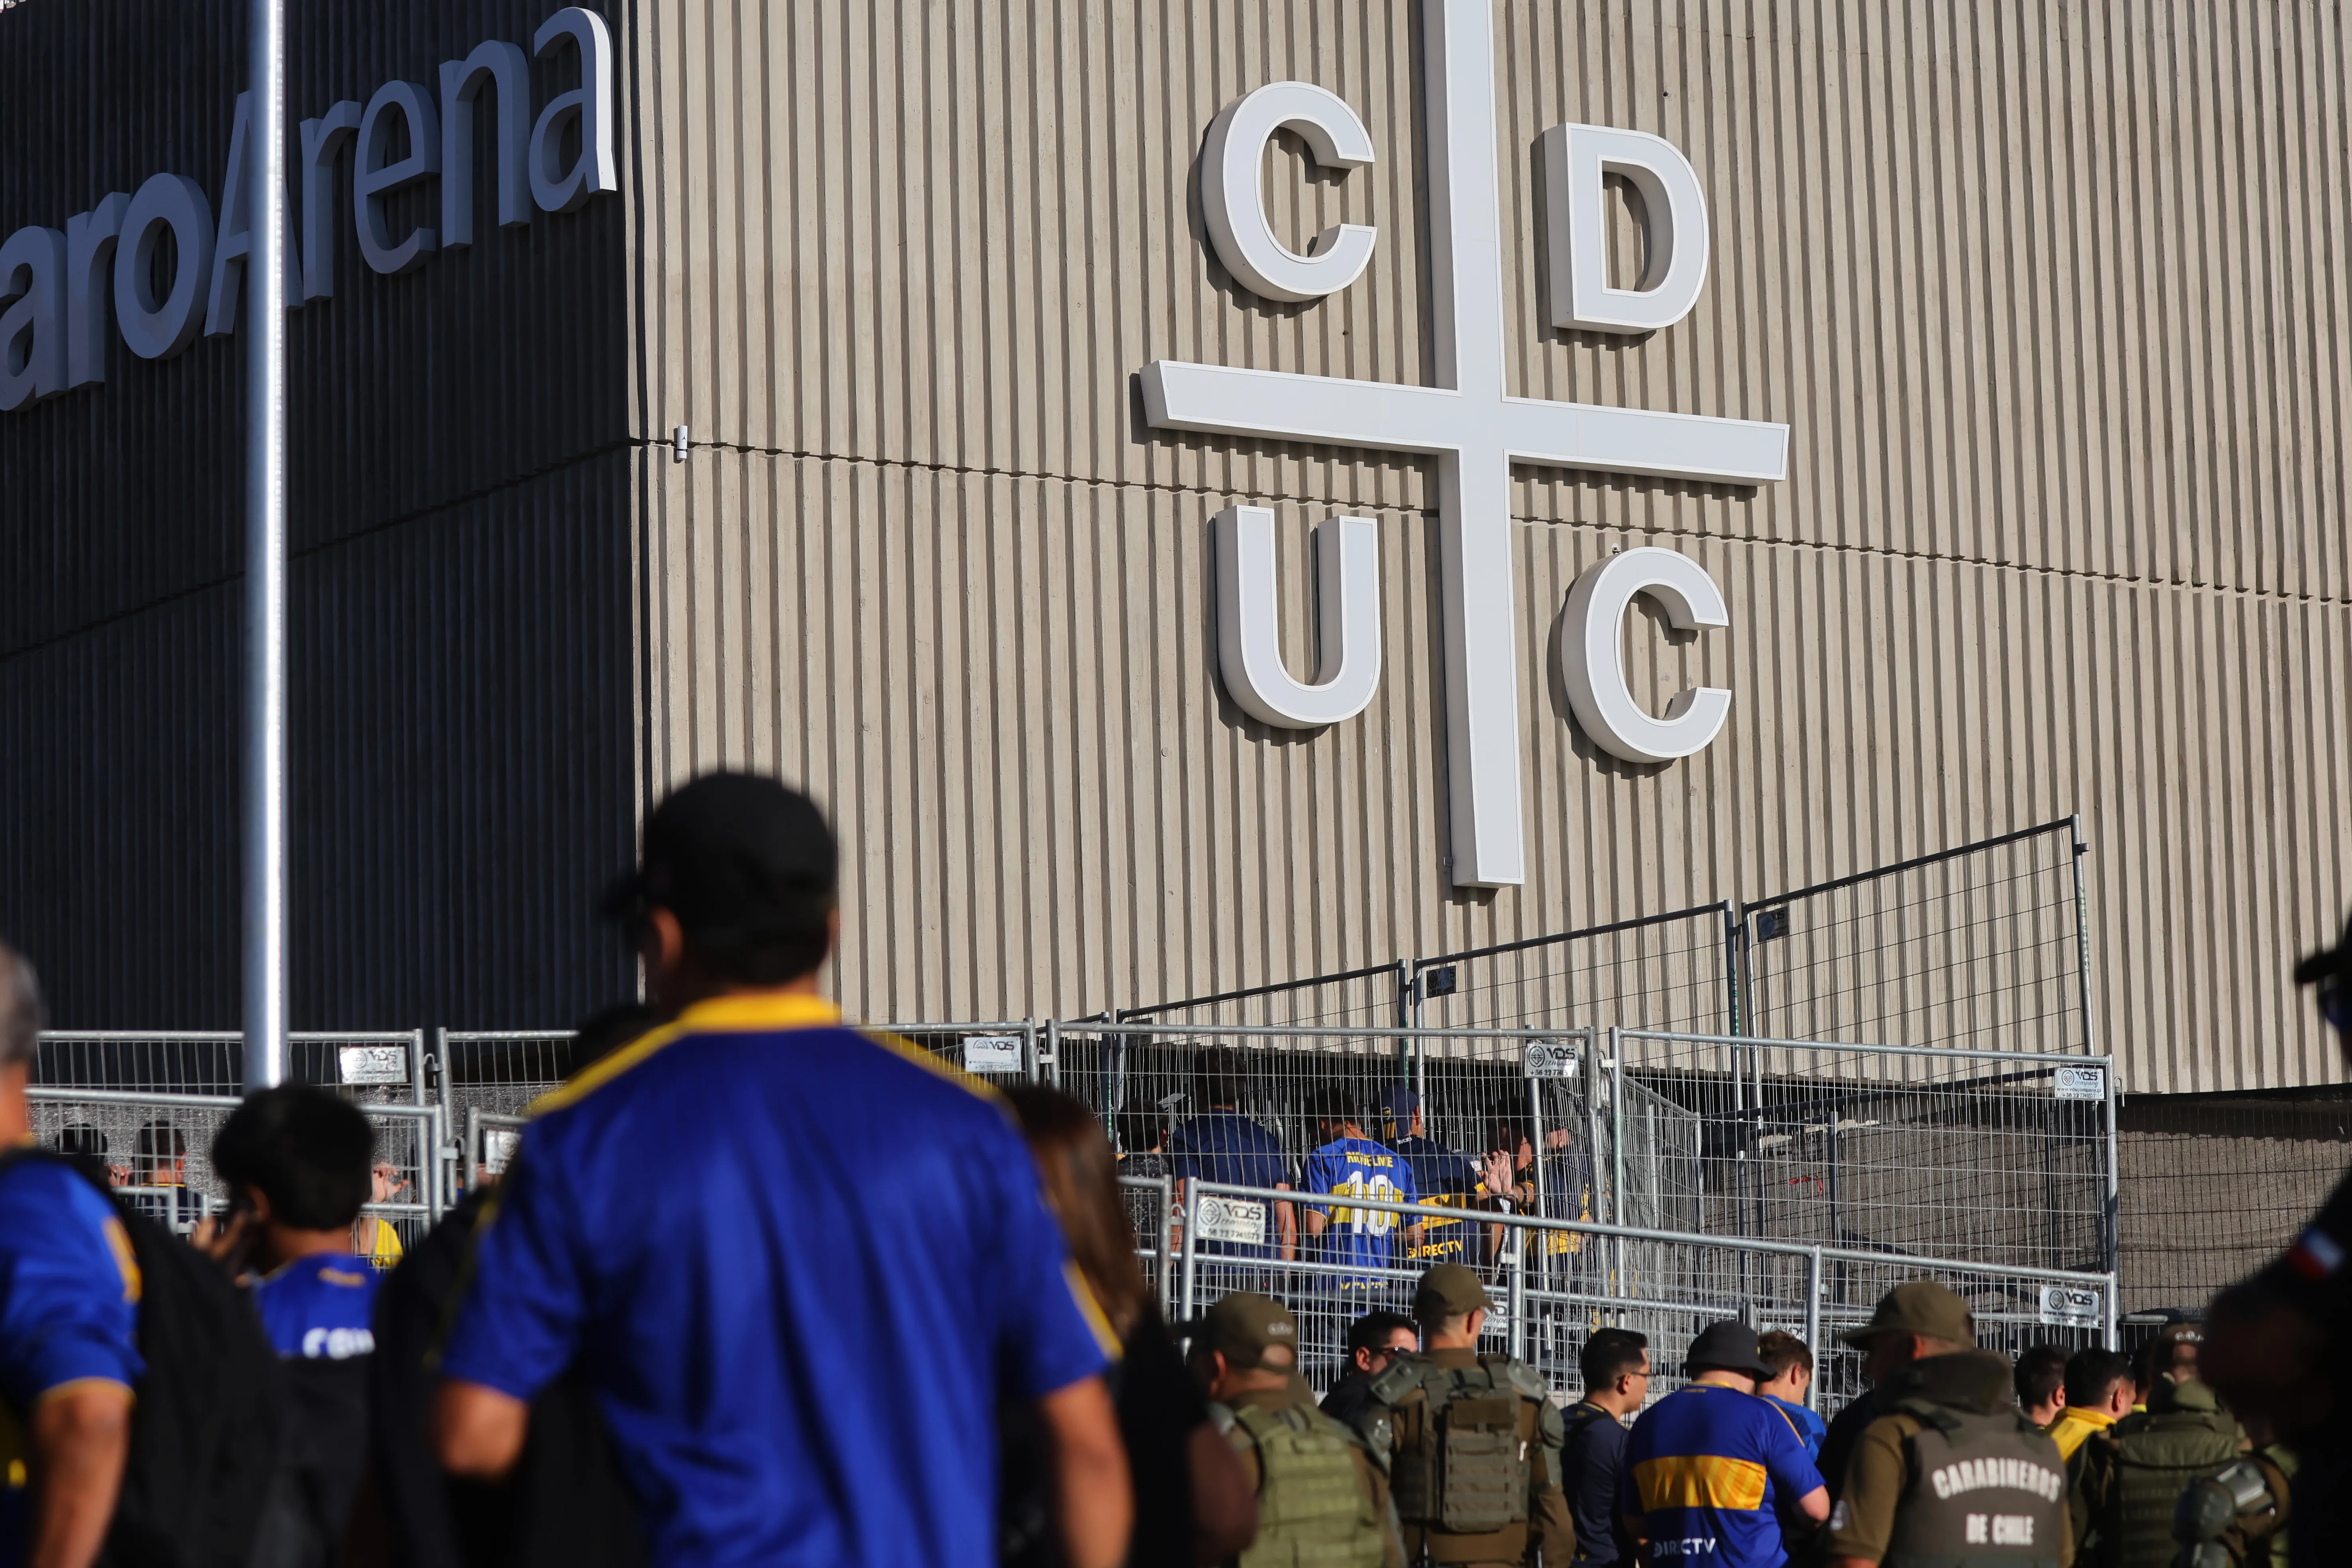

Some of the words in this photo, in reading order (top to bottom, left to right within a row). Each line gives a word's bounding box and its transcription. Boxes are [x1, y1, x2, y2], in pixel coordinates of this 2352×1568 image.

[1206, 80, 1377, 301] C
[1548, 122, 1710, 333] D
[1218, 505, 1382, 727] U
[1564, 547, 1732, 762] C
[989, 1041, 1014, 1050] VDS
[1547, 1048, 1575, 1059] VDS
[2075, 1071, 2098, 1081] VDS
[1224, 1204, 1261, 1220] VDS
[1347, 1170, 1394, 1236] 10
[1408, 1240, 1462, 1259] DIRECTV
[2065, 1292, 2093, 1305] VDS
[1932, 1457, 2061, 1504] CARABINEROS
[1966, 1513, 1988, 1544] DE
[1992, 1514, 2034, 1546] CHILE
